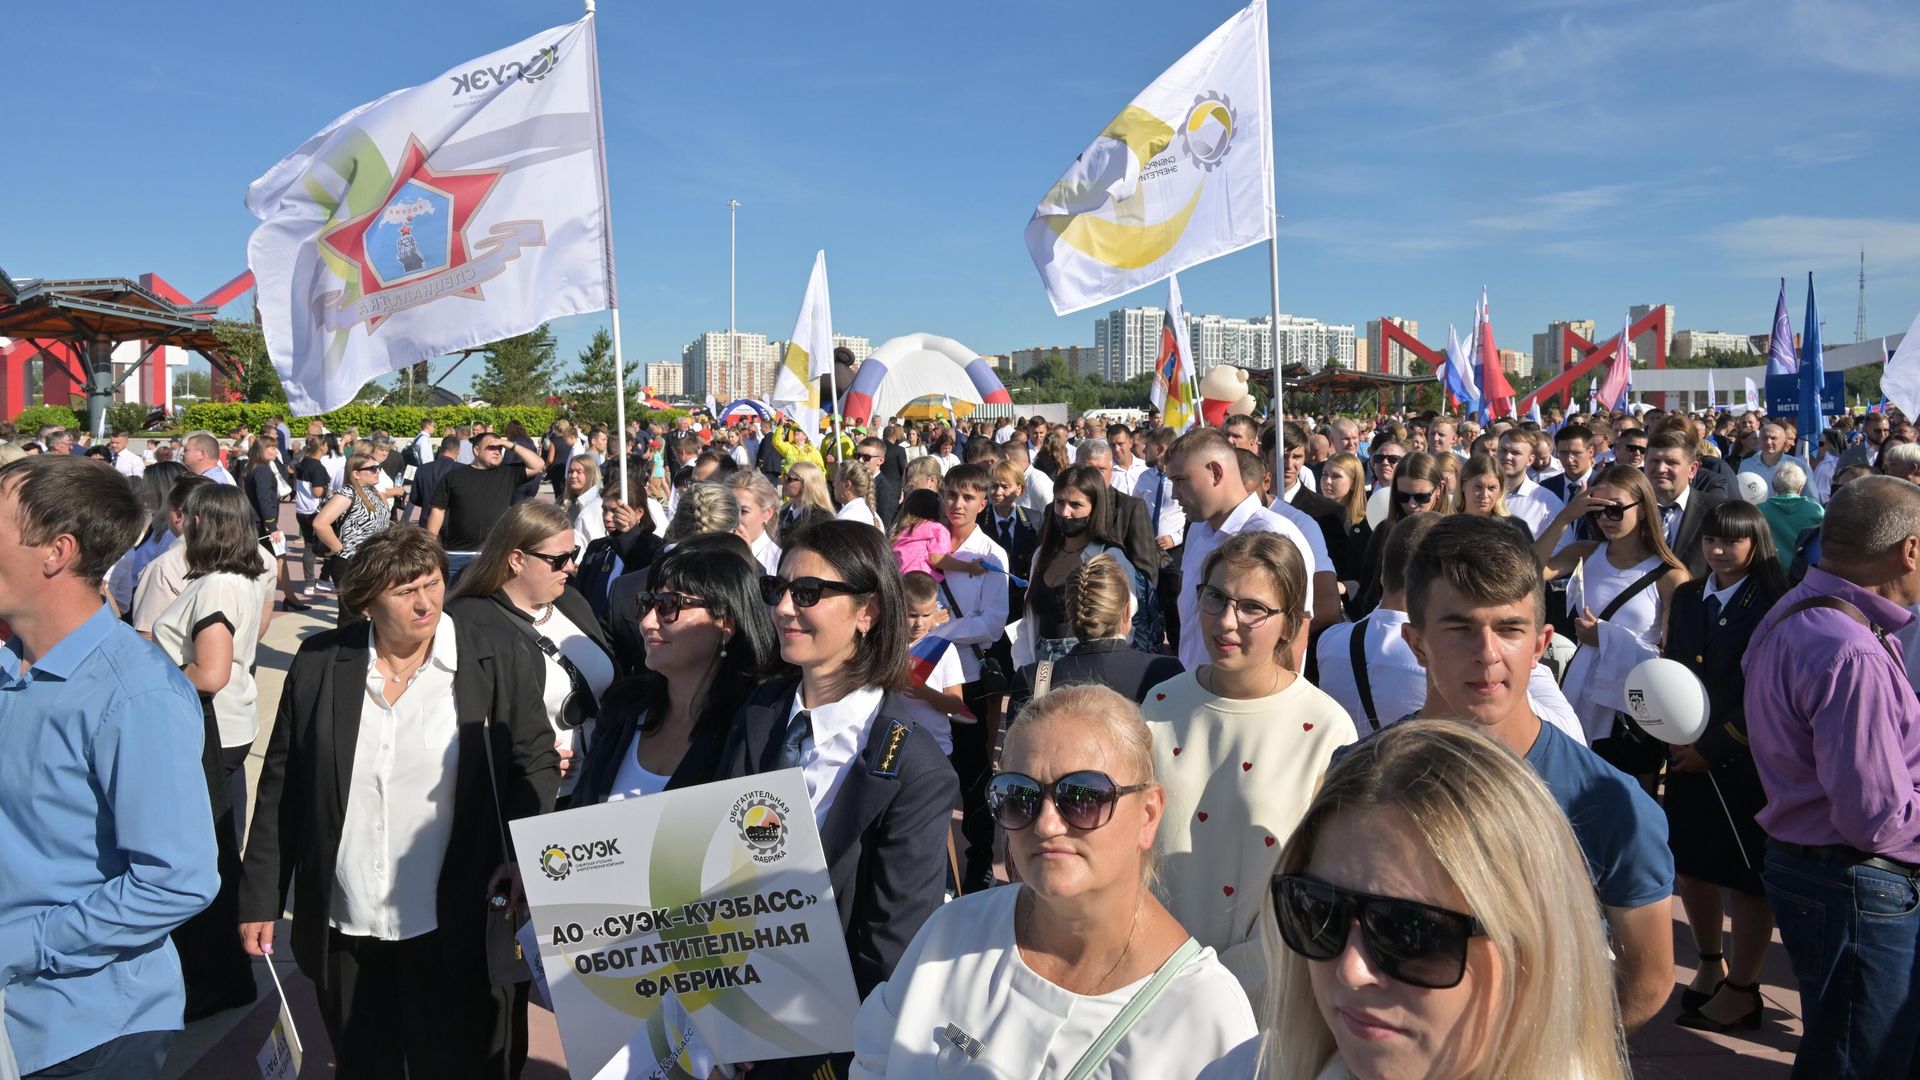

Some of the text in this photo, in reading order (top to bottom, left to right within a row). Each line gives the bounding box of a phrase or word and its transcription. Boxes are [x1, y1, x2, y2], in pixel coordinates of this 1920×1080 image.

[729, 790, 790, 823] ОБОГАТИТЕЛЬНАЯ
[571, 838, 622, 861] СУЭК
[752, 850, 787, 863] ФАБРИКА
[552, 923, 584, 946] АО
[574, 923, 810, 975] ОБОГАТИТЕЛЬНАЯ
[635, 964, 762, 999] ФАБРИКА
